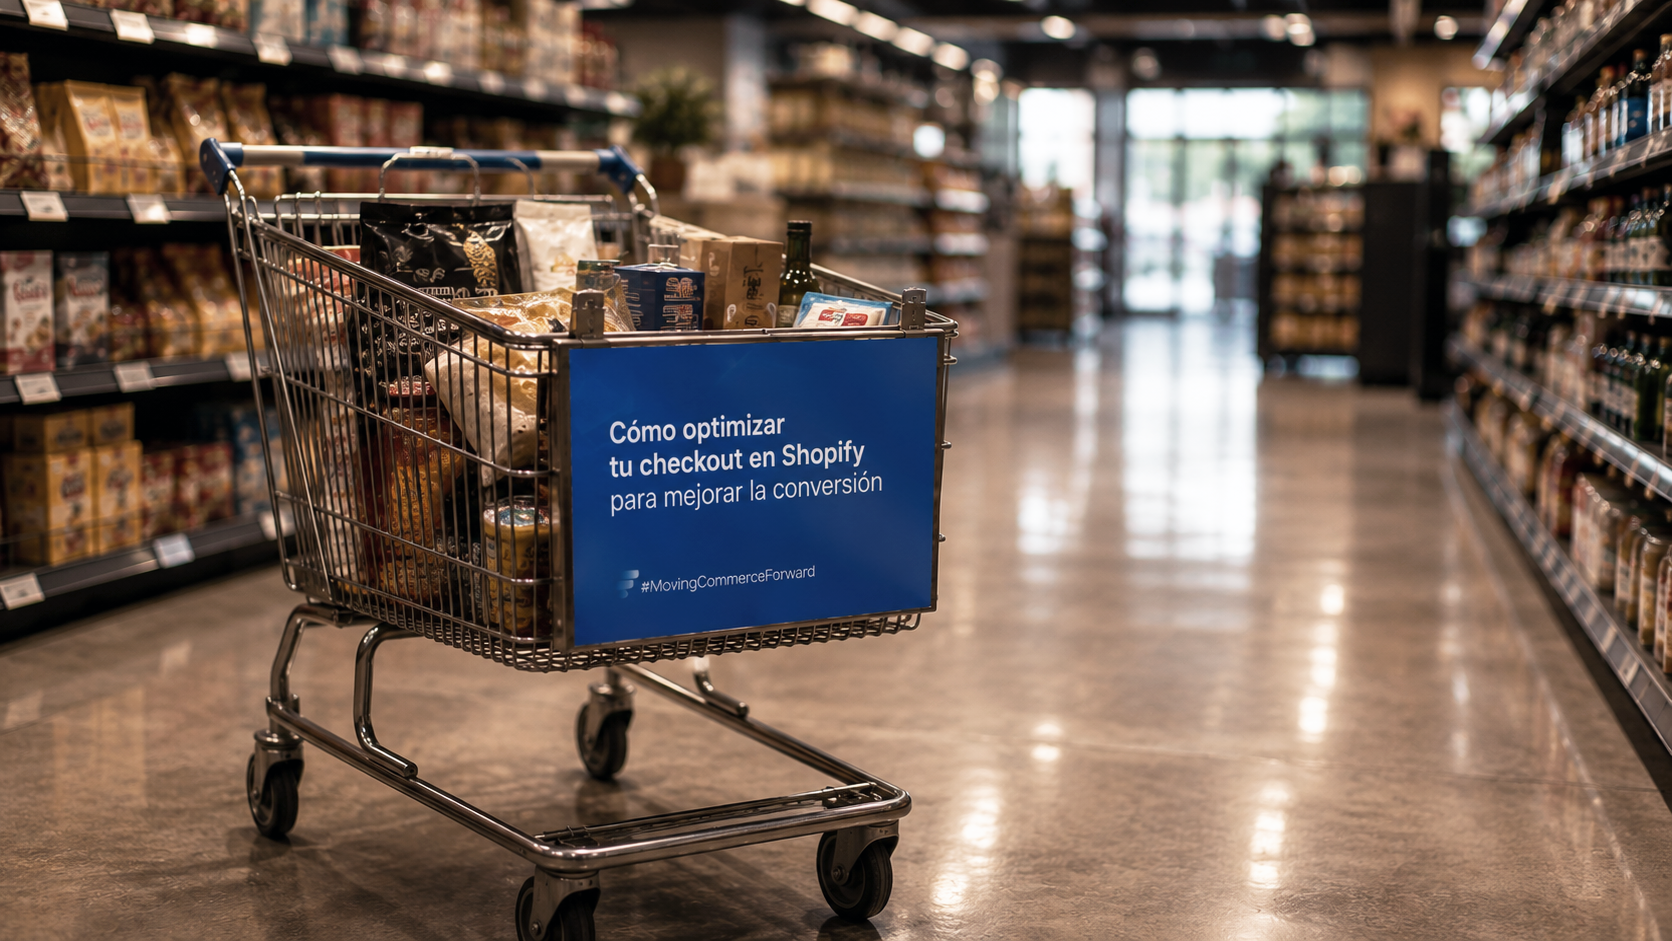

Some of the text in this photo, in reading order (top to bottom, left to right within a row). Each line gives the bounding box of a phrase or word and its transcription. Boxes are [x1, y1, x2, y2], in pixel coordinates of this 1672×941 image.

[609, 412, 786, 445] Cómo optimizar
[609, 439, 866, 479] tu checkout en Shopify
[610, 470, 884, 517] para mejorar la conversión
[640, 565, 816, 594] #MovingCommerceForward
